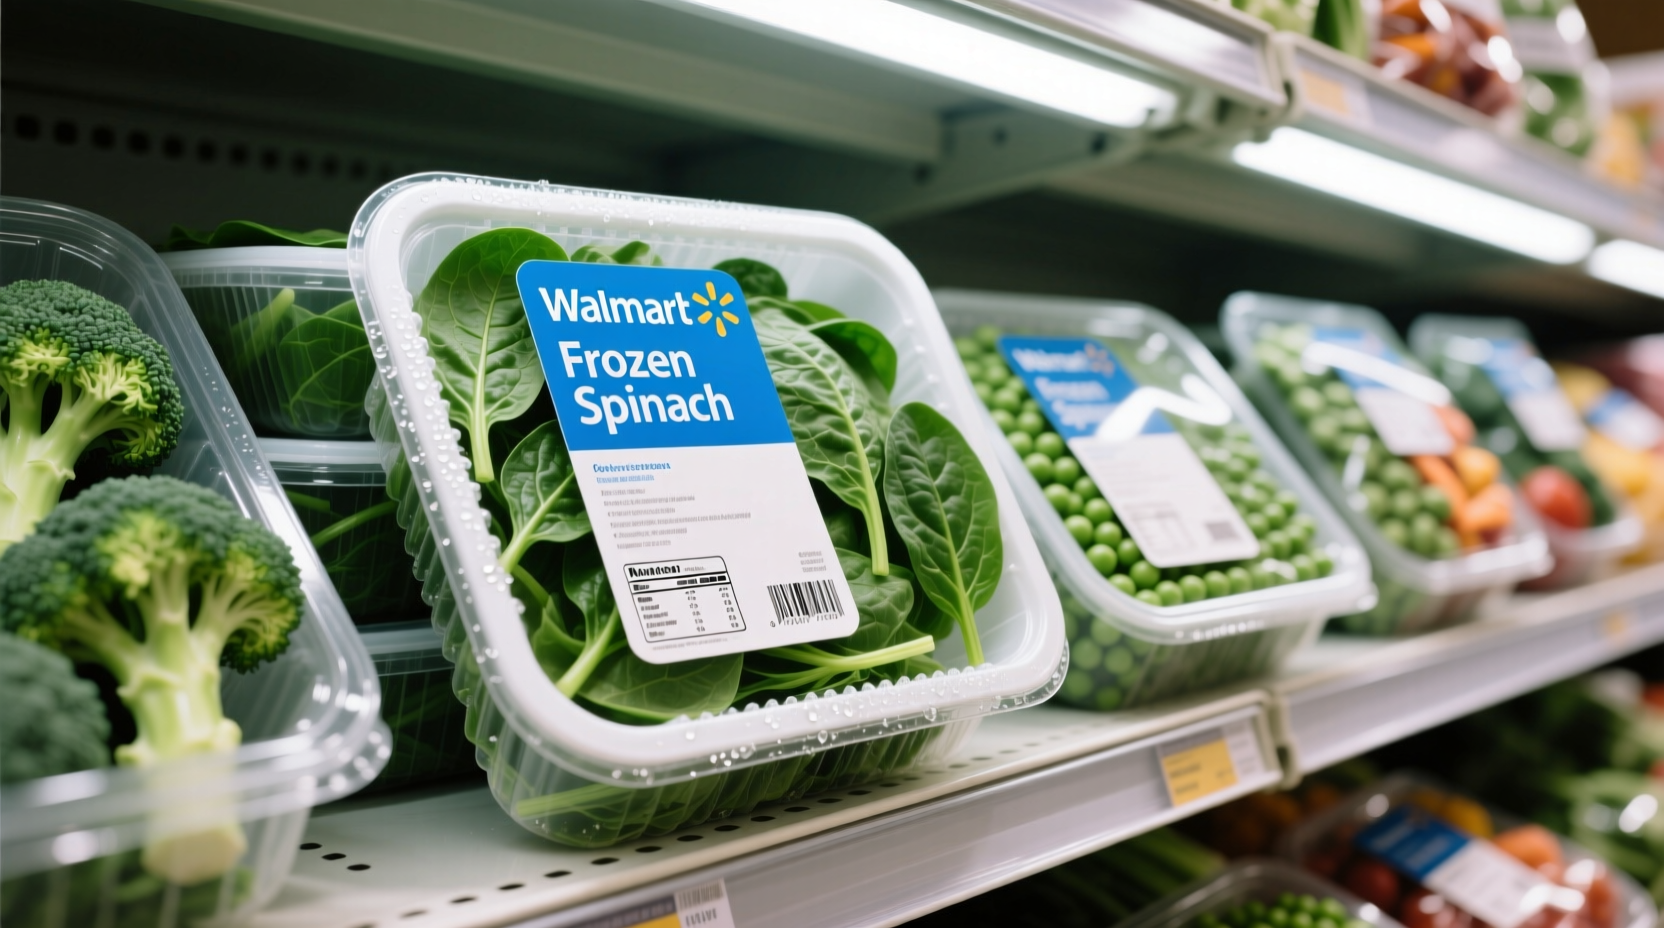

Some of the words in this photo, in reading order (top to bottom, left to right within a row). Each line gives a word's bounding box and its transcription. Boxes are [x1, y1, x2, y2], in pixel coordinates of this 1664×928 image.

[538, 287, 693, 326] Walmart
[559, 341, 696, 377] Frozen
[574, 383, 735, 435] Spinach
